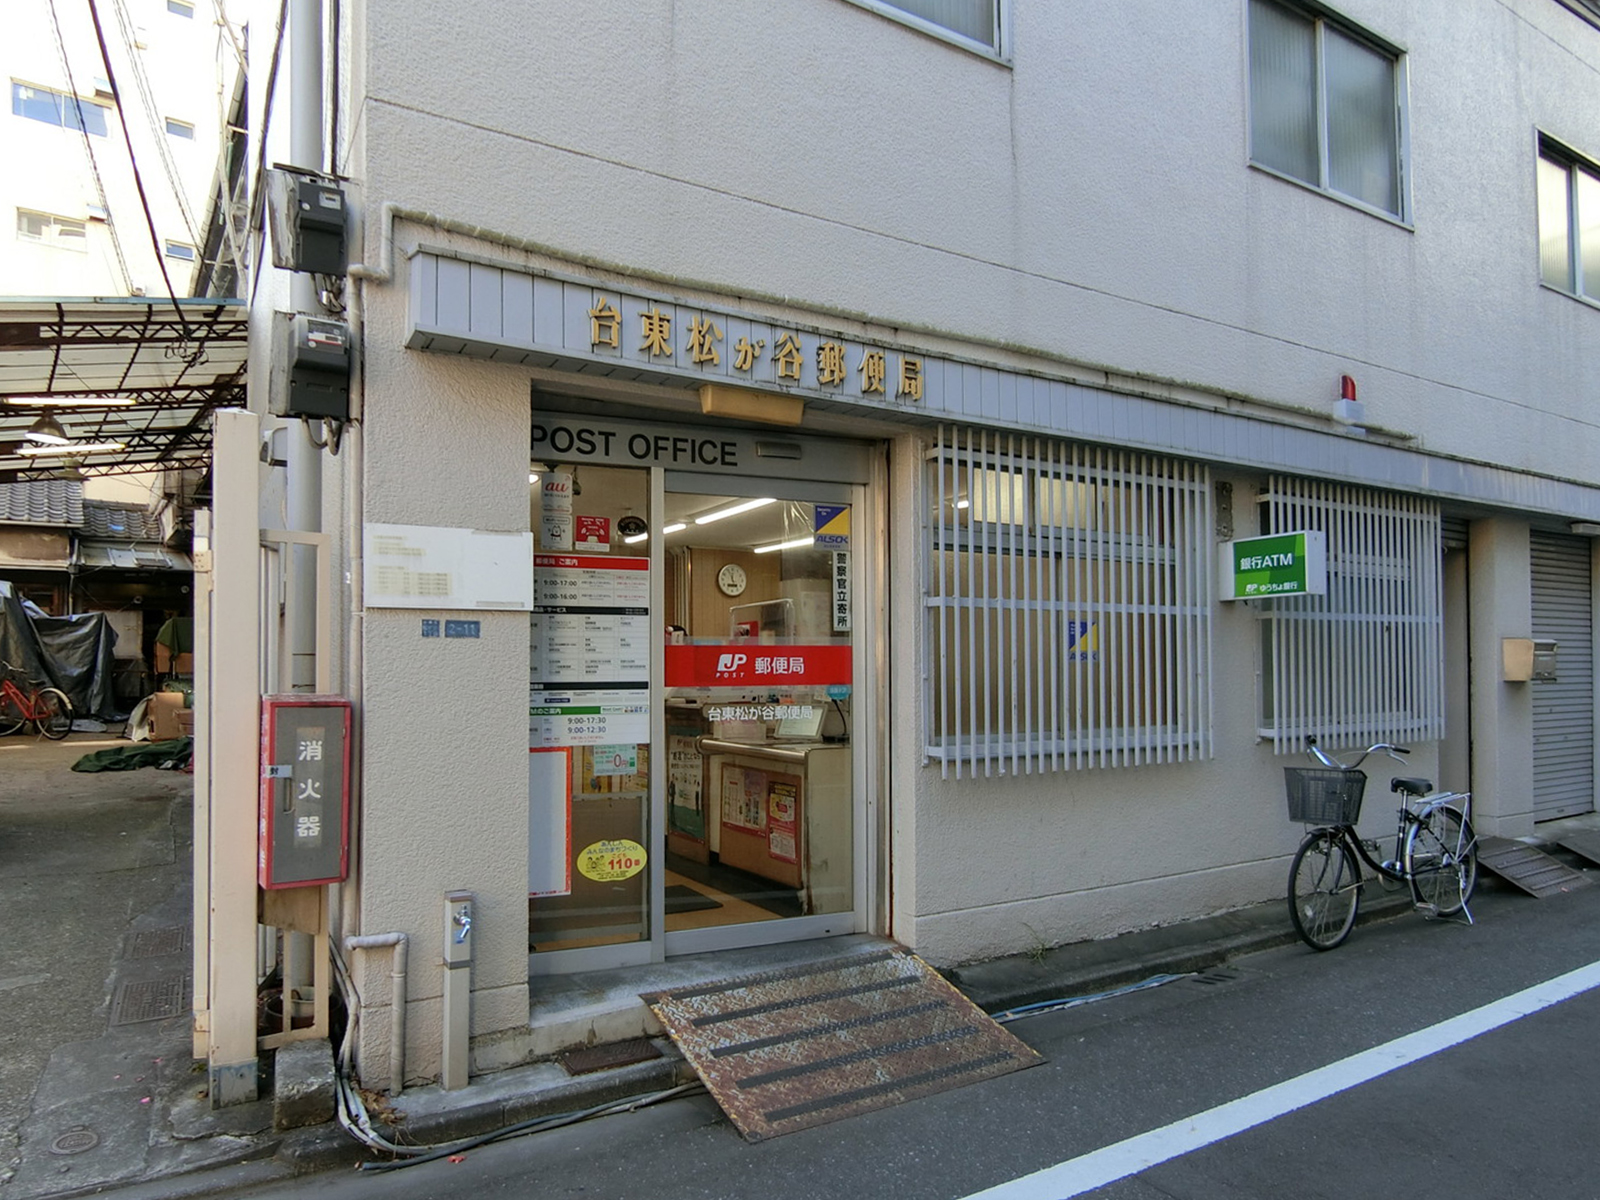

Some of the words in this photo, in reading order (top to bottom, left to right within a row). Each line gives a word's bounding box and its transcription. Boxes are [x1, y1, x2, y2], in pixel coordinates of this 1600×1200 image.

[587, 296, 923, 400] 台東松が谷郵便局
[531, 424, 616, 456] POST
[628, 433, 738, 467] OFFICE
[545, 481, 569, 492] au
[816, 535, 849, 544] ALSOK
[1240, 552, 1293, 571] 銀行ATM
[836, 552, 848, 627] 警察官立寄所
[1259, 581, 1298, 592] ゆうちょ銀行
[755, 657, 804, 674] 郵便局
[707, 705, 813, 721] 台東松が谷郵便局
[297, 739, 322, 837] 消火器
